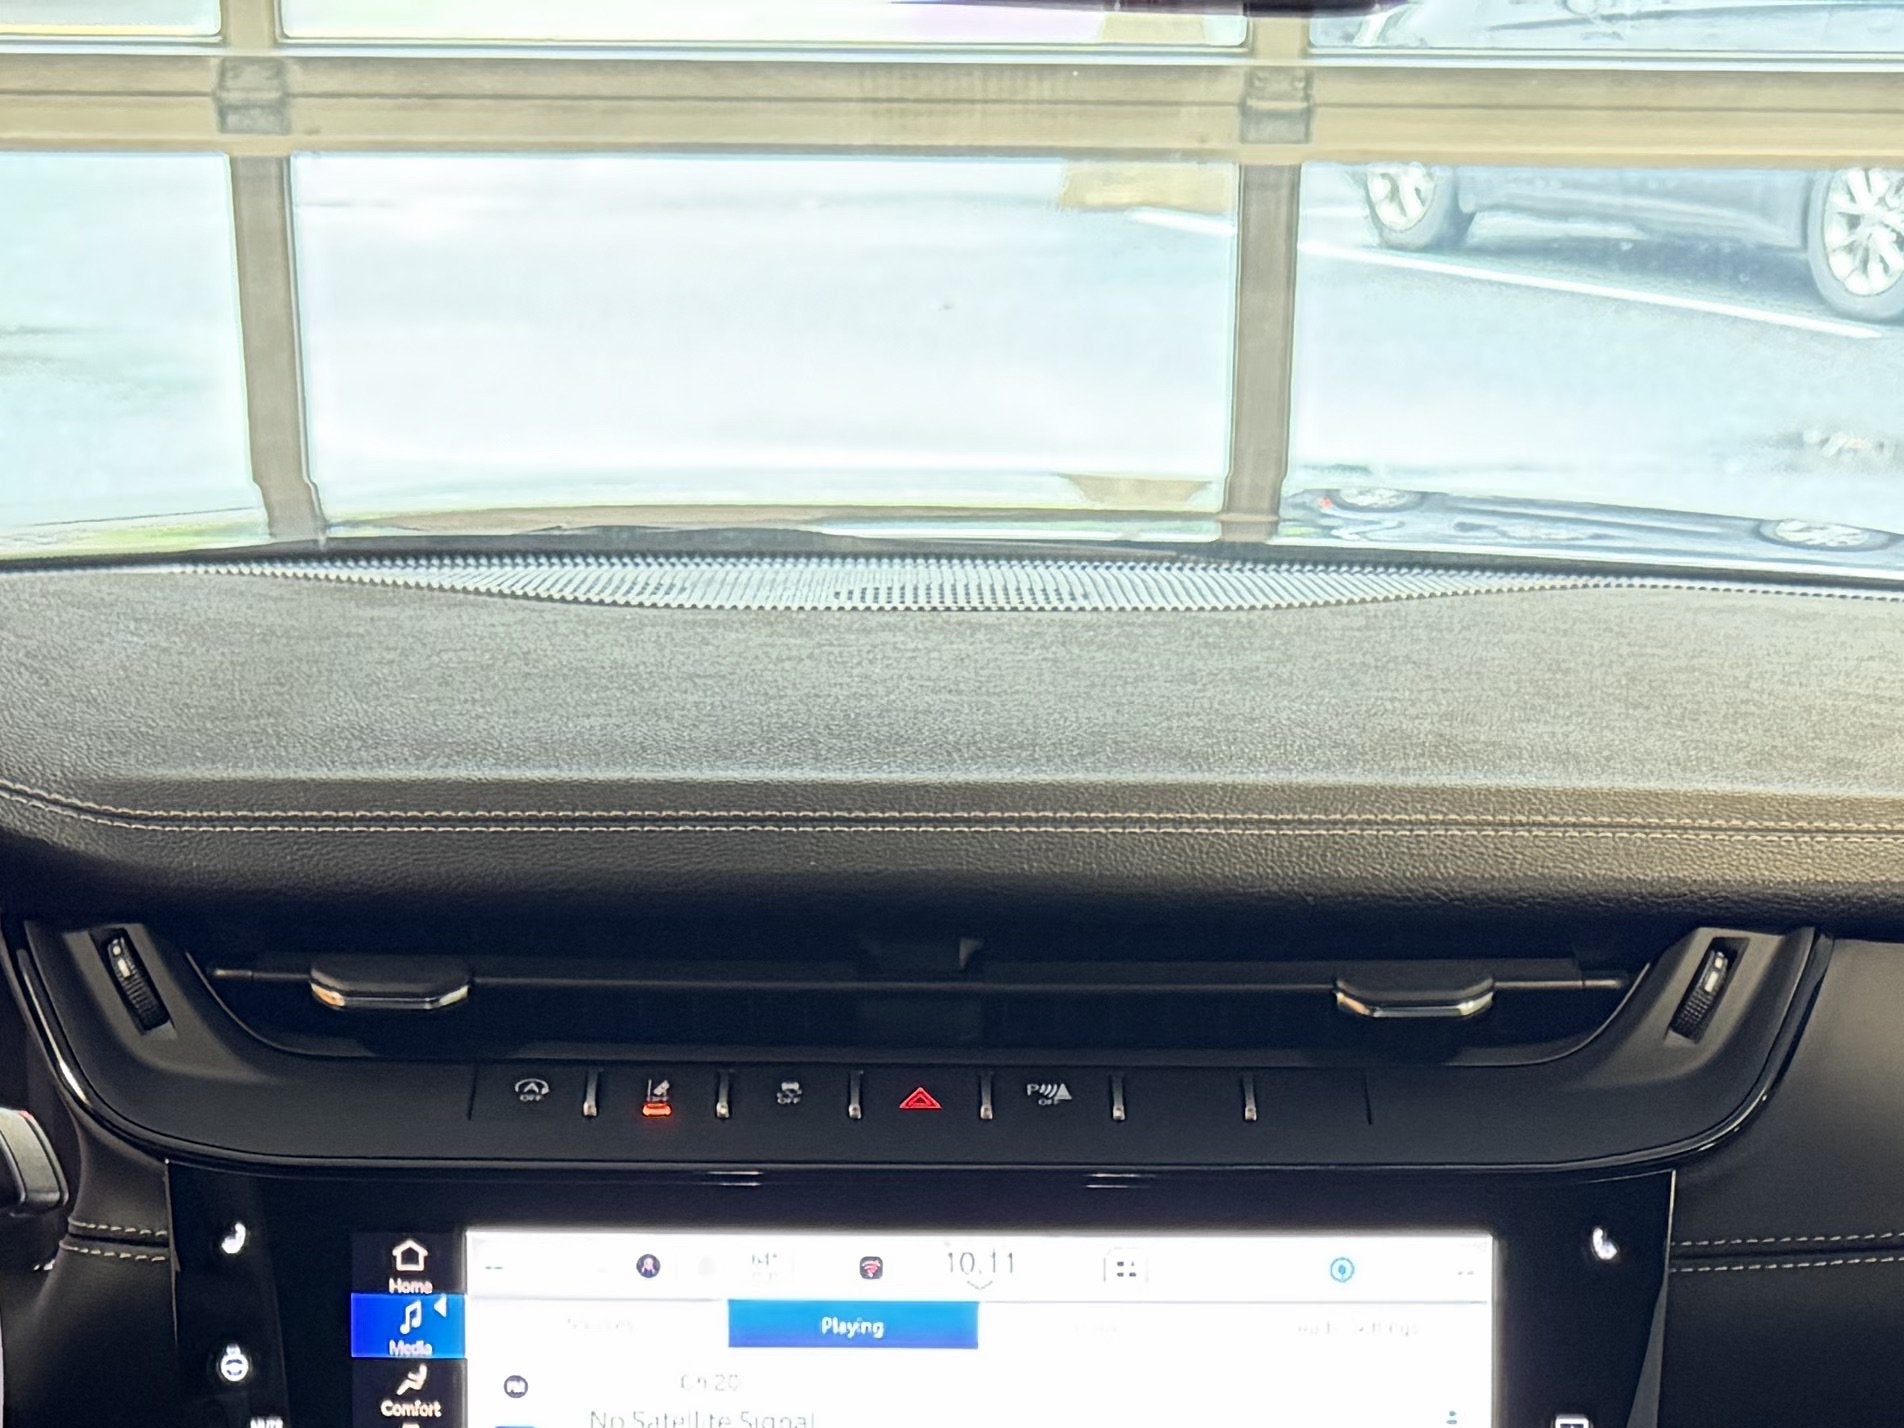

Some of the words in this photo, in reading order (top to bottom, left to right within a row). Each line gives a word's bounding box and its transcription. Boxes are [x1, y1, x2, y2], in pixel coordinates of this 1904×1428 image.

[388, 1278, 434, 1294] Home
[821, 1315, 885, 1339] Playing
[388, 1340, 434, 1357] Media
[380, 1399, 443, 1419] Comfort
